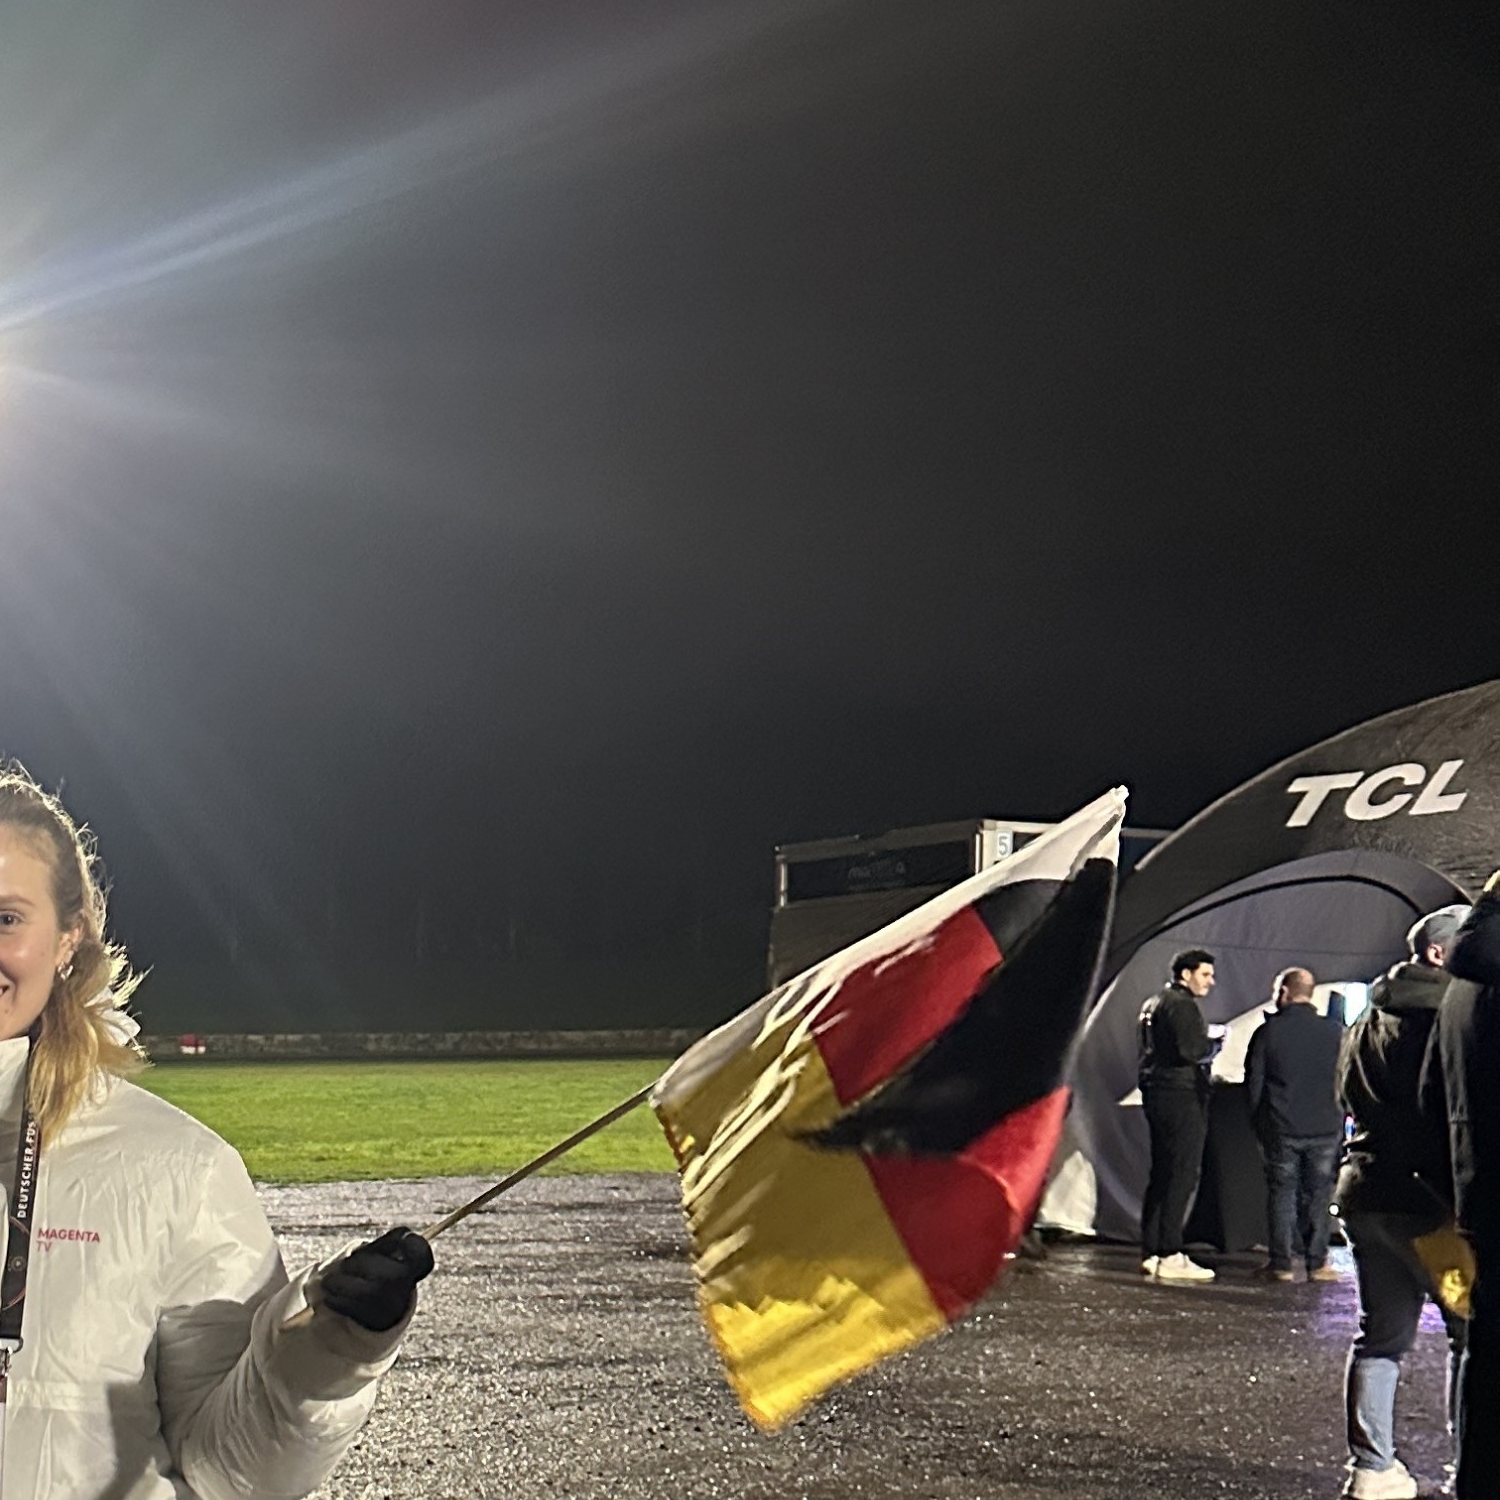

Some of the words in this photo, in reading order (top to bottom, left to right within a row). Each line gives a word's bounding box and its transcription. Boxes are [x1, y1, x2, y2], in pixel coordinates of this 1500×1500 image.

[1285, 759, 1467, 828] TCL
[998, 835, 1009, 856] 5
[17, 1147, 35, 1219] DEUTSCHER
[37, 1227, 100, 1243] MAGENTA
[36, 1241, 53, 1252] TV
